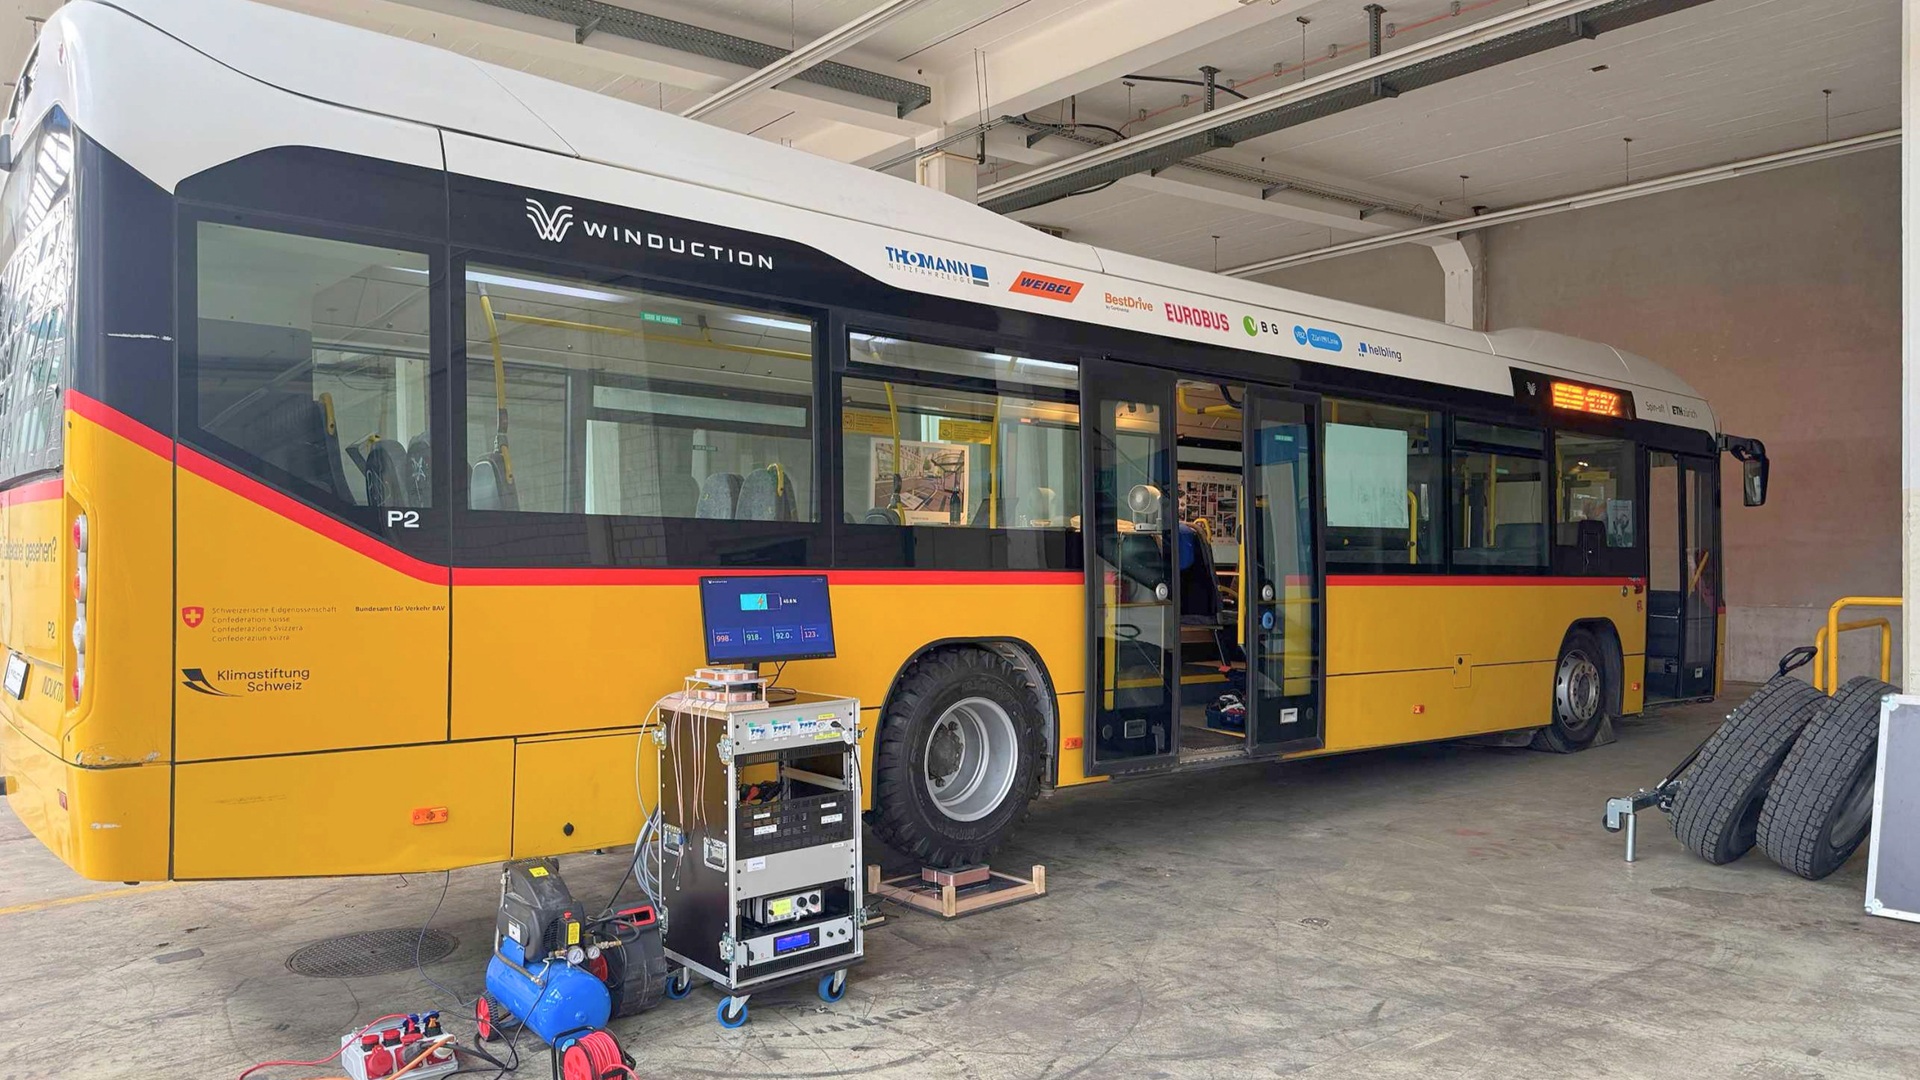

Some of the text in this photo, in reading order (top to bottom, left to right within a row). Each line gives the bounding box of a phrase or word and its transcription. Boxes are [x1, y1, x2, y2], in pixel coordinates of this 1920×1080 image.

[583, 221, 773, 270] WINDUCTION
[885, 246, 970, 277] THOMANN
[888, 263, 972, 285] NUTZFAHRZEUGE
[1020, 277, 1072, 296] WEIBEL
[1104, 292, 1154, 312] BestDrive
[1164, 302, 1230, 332] EUROBUS
[1367, 343, 1402, 363] helbling
[387, 510, 420, 528] P2
[211, 606, 337, 615] Schweizerische Eidgenossenschaft
[47, 620, 56, 639] P2
[211, 625, 272, 633] Confederazione
[775, 632, 790, 640] 92.0
[217, 668, 310, 681] Klimastiftung
[247, 680, 302, 692] Schweiz
